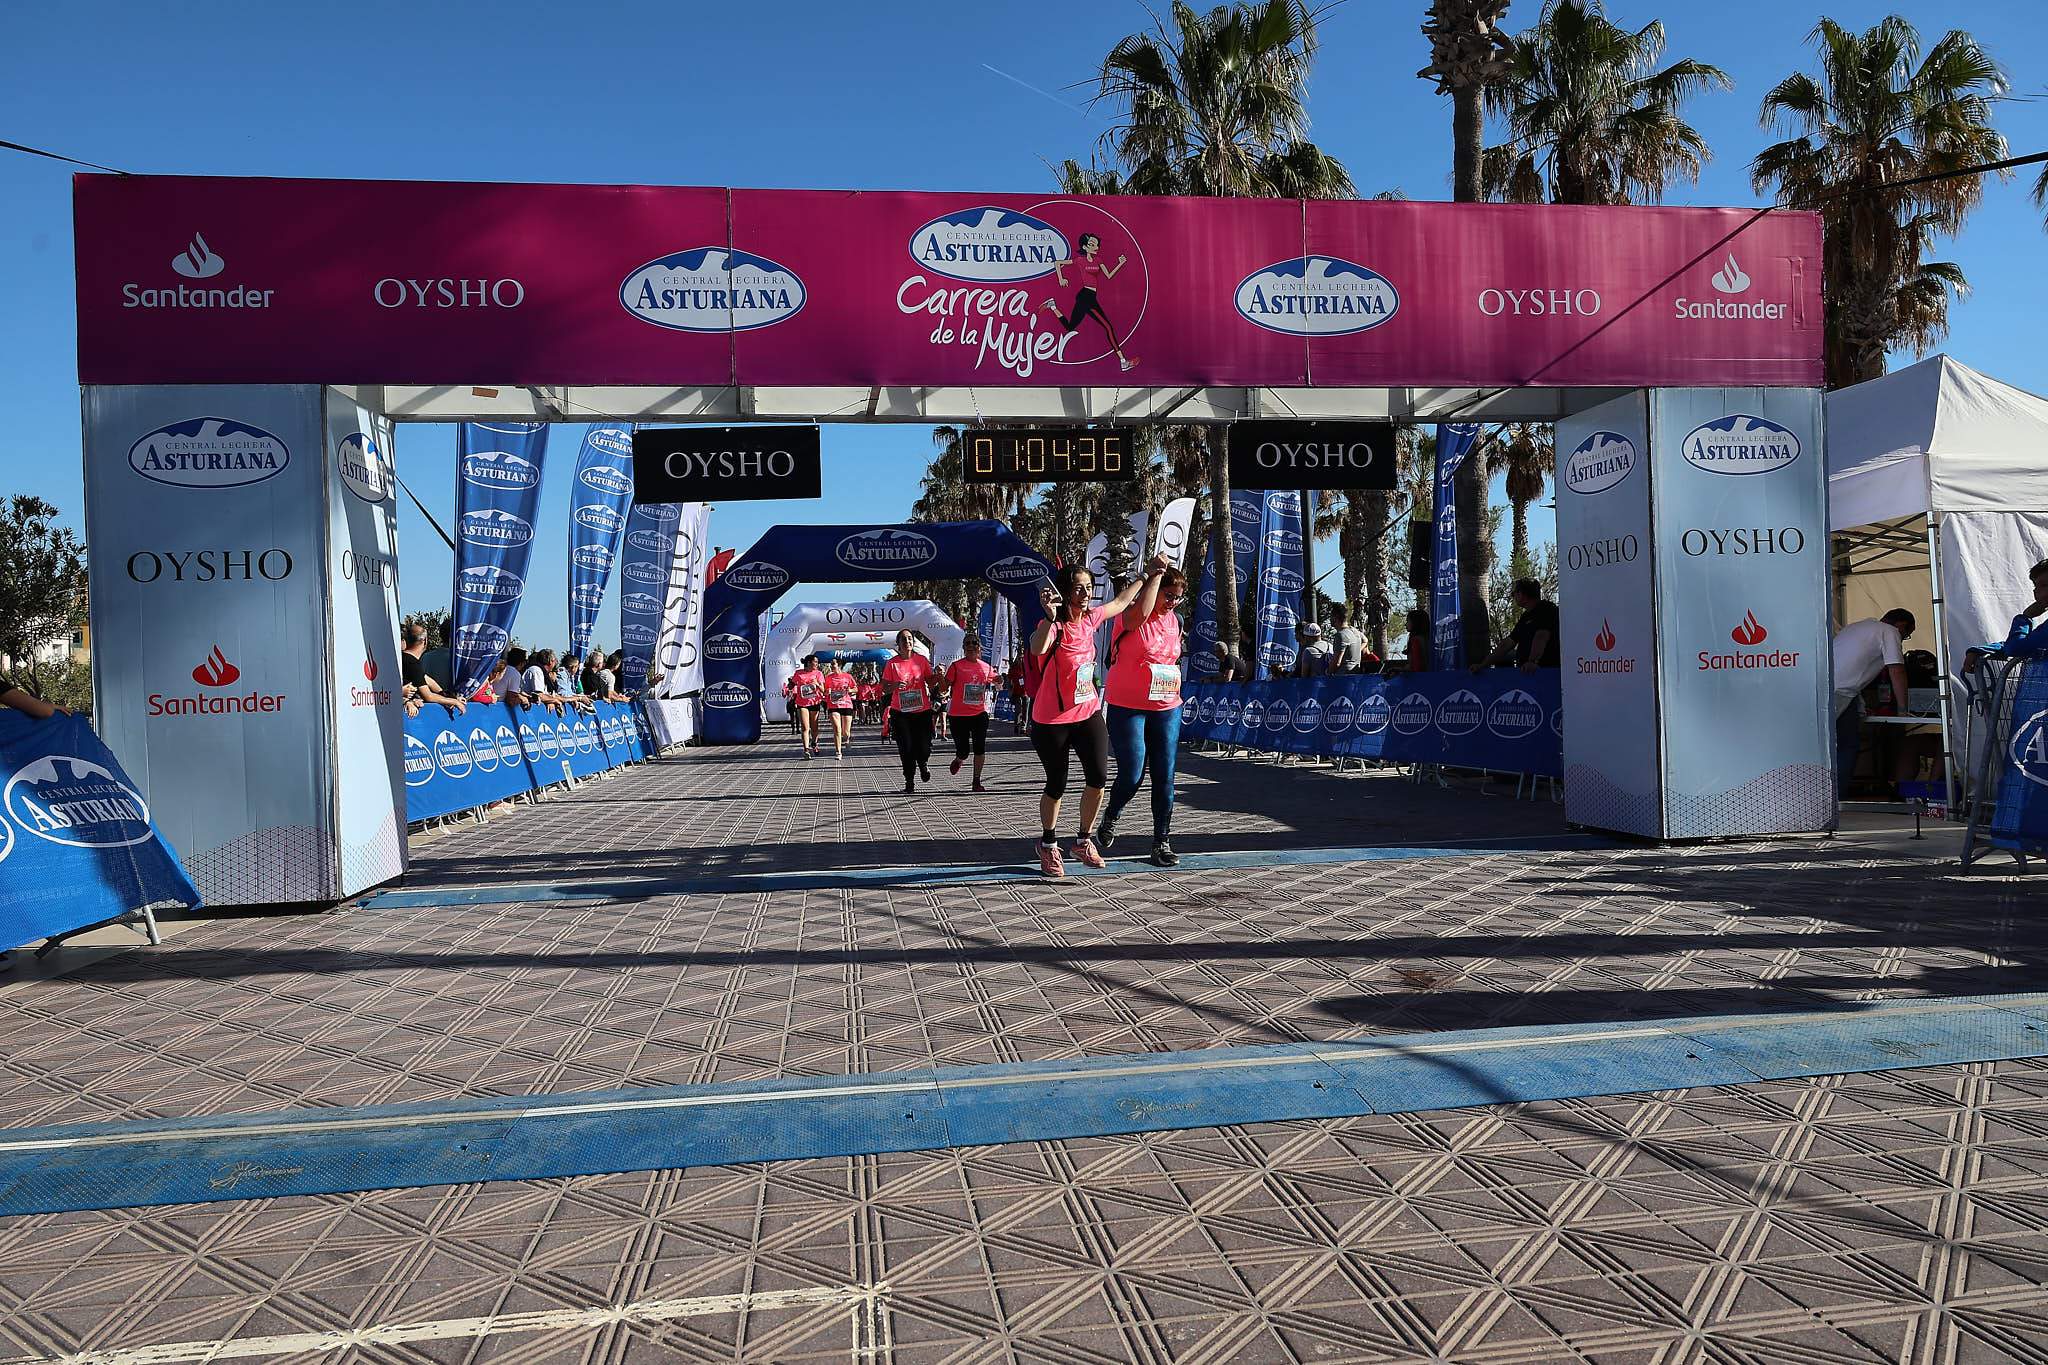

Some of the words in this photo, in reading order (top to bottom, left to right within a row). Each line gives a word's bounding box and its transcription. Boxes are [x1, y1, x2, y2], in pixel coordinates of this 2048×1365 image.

[947, 231, 997, 241] CENTRAL
[1002, 232, 1054, 242] LECHERA
[922, 232, 1057, 264] ASTURIANA
[663, 276, 721, 285] CENTRAL
[1272, 283, 1324, 291] CENTRAL
[1328, 283, 1381, 292] LECHERA
[123, 283, 274, 309] Santander
[373, 278, 525, 309] OYSHO
[634, 278, 793, 310] ASTURIANA
[896, 275, 1030, 317] Carrera
[1247, 284, 1387, 315] ASTURIANA
[1478, 288, 1602, 317] OYSHO
[1675, 298, 1788, 320] Santander
[930, 316, 955, 345] de
[959, 317, 978, 345] la
[974, 310, 1079, 378] Mujer
[165, 441, 218, 450] CENTRAL
[221, 440, 273, 449] LECHERA
[592, 434, 633, 454] ASTURIAN
[1708, 435, 1746, 443] CENTRAL
[1748, 434, 1788, 442] LECHERA
[141, 444, 279, 471] ASTURIANA
[1256, 442, 1373, 468] OYSHO
[1578, 453, 1601, 465] CENTRAL
[1690, 437, 1792, 461] ASTURIANA
[464, 461, 535, 484] ASTURIANA
[664, 450, 795, 479] OYSHO
[1569, 453, 1631, 486] ASTURIANA
[584, 472, 630, 492] ASTURIANA
[637, 504, 676, 519] ASTURIANA
[1231, 508, 1260, 521] STURIANA
[1270, 498, 1301, 513] ASTURIA
[462, 520, 528, 541] ASTURIANA
[631, 534, 671, 549] ASTURIANA
[844, 542, 930, 561] ASTURIANA
[1267, 536, 1303, 552] ASTURIAN
[1681, 527, 1805, 557] OYSHO
[1568, 533, 1639, 571] OYSHO
[126, 548, 294, 584] OYSHO
[342, 549, 393, 589] OYSHO
[625, 567, 665, 581] ASTURIANA
[991, 566, 1045, 580] ASTURIANA
[729, 572, 784, 584] ASTURIANA
[826, 606, 905, 625] OYSHO
[624, 632, 656, 643] STURIANA
[706, 643, 749, 655] ASTURIANA
[1577, 655, 1635, 675] Santander
[1698, 649, 1800, 671] Santander
[147, 691, 286, 716] Santander
[351, 686, 392, 708] Santander
[706, 691, 749, 702] ASTURIANA
[1394, 708, 1429, 724] ASTURIANA
[1437, 706, 1480, 724] ASTURIANA
[1490, 707, 1536, 727] ASTURIANA
[37, 785, 89, 801] CENTRAL
[88, 784, 124, 795] LECHE
[21, 795, 143, 832] ASTURIAN
